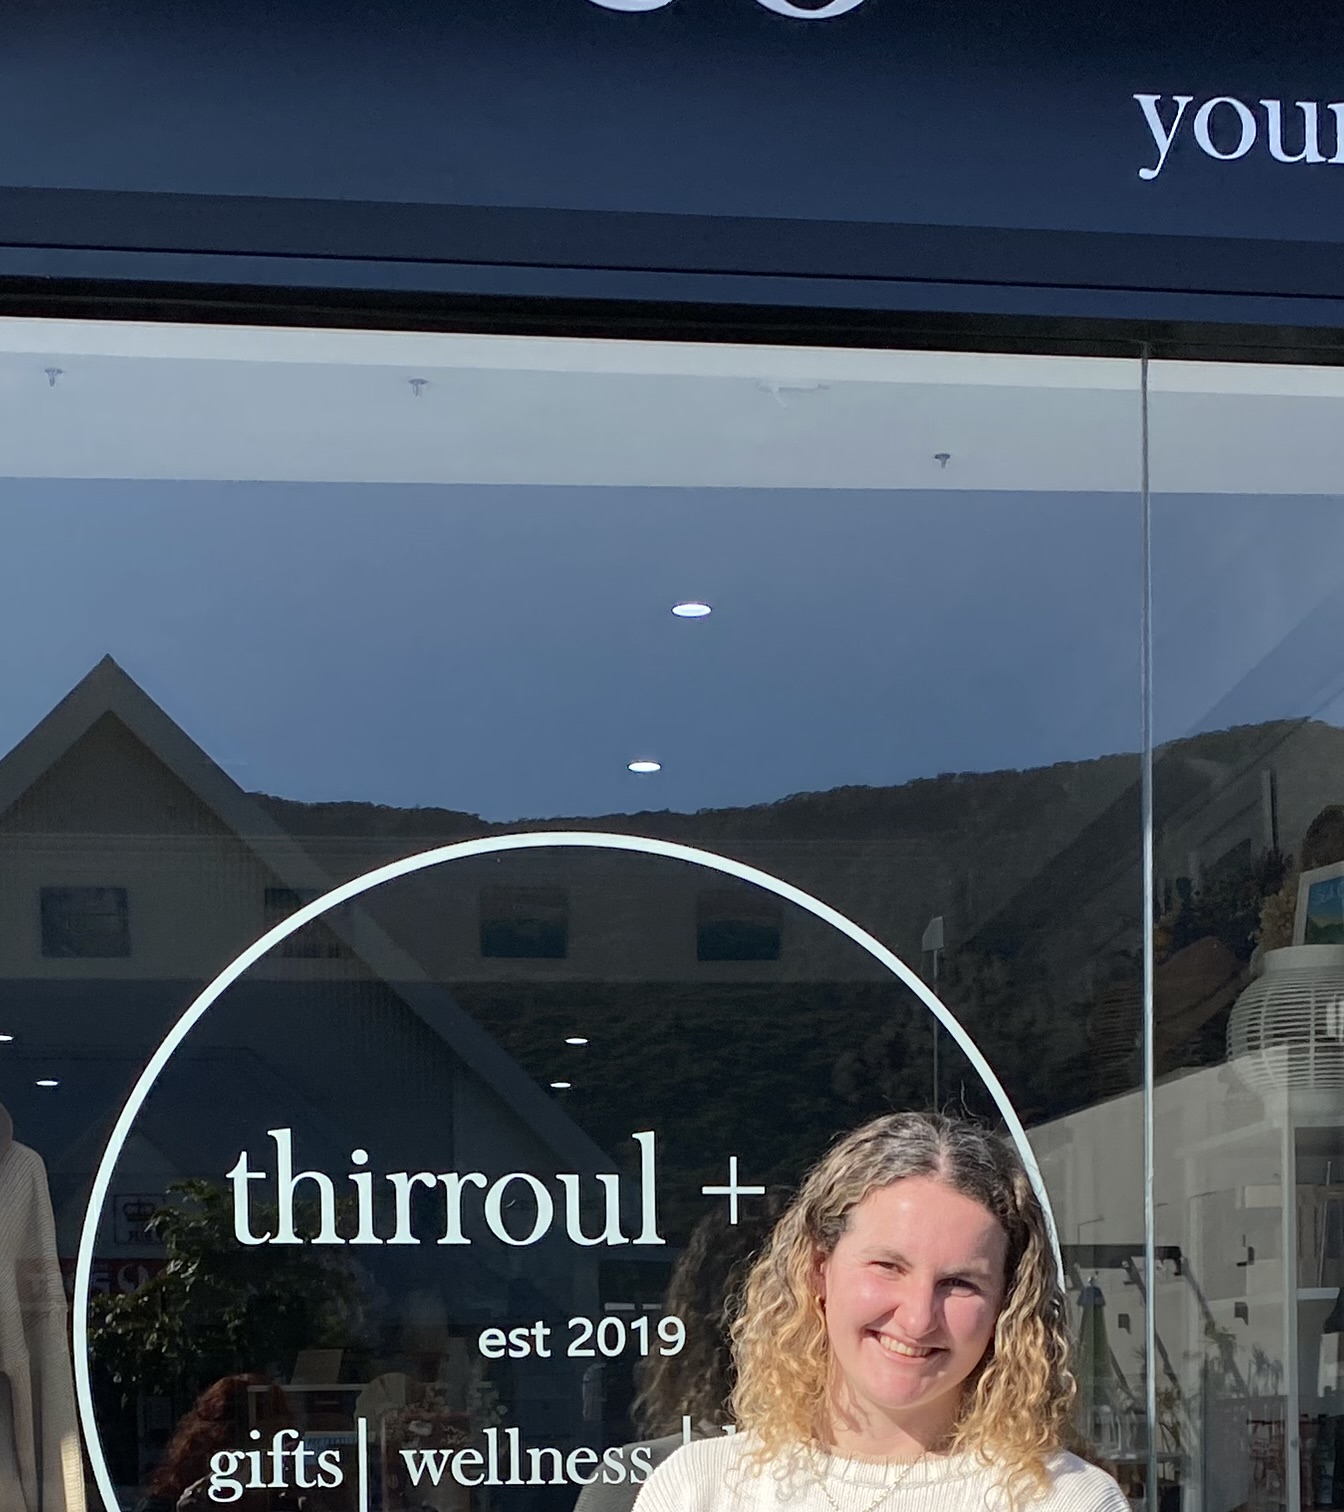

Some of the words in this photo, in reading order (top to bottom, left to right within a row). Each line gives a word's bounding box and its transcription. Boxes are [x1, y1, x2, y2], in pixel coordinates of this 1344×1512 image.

[226, 1127, 666, 1246] thirroul
[702, 1156, 766, 1225] +
[478, 1320, 551, 1359] est
[567, 1316, 686, 1358] 2019
[207, 1429, 344, 1503] gifts
[398, 1427, 655, 1486] wellness
